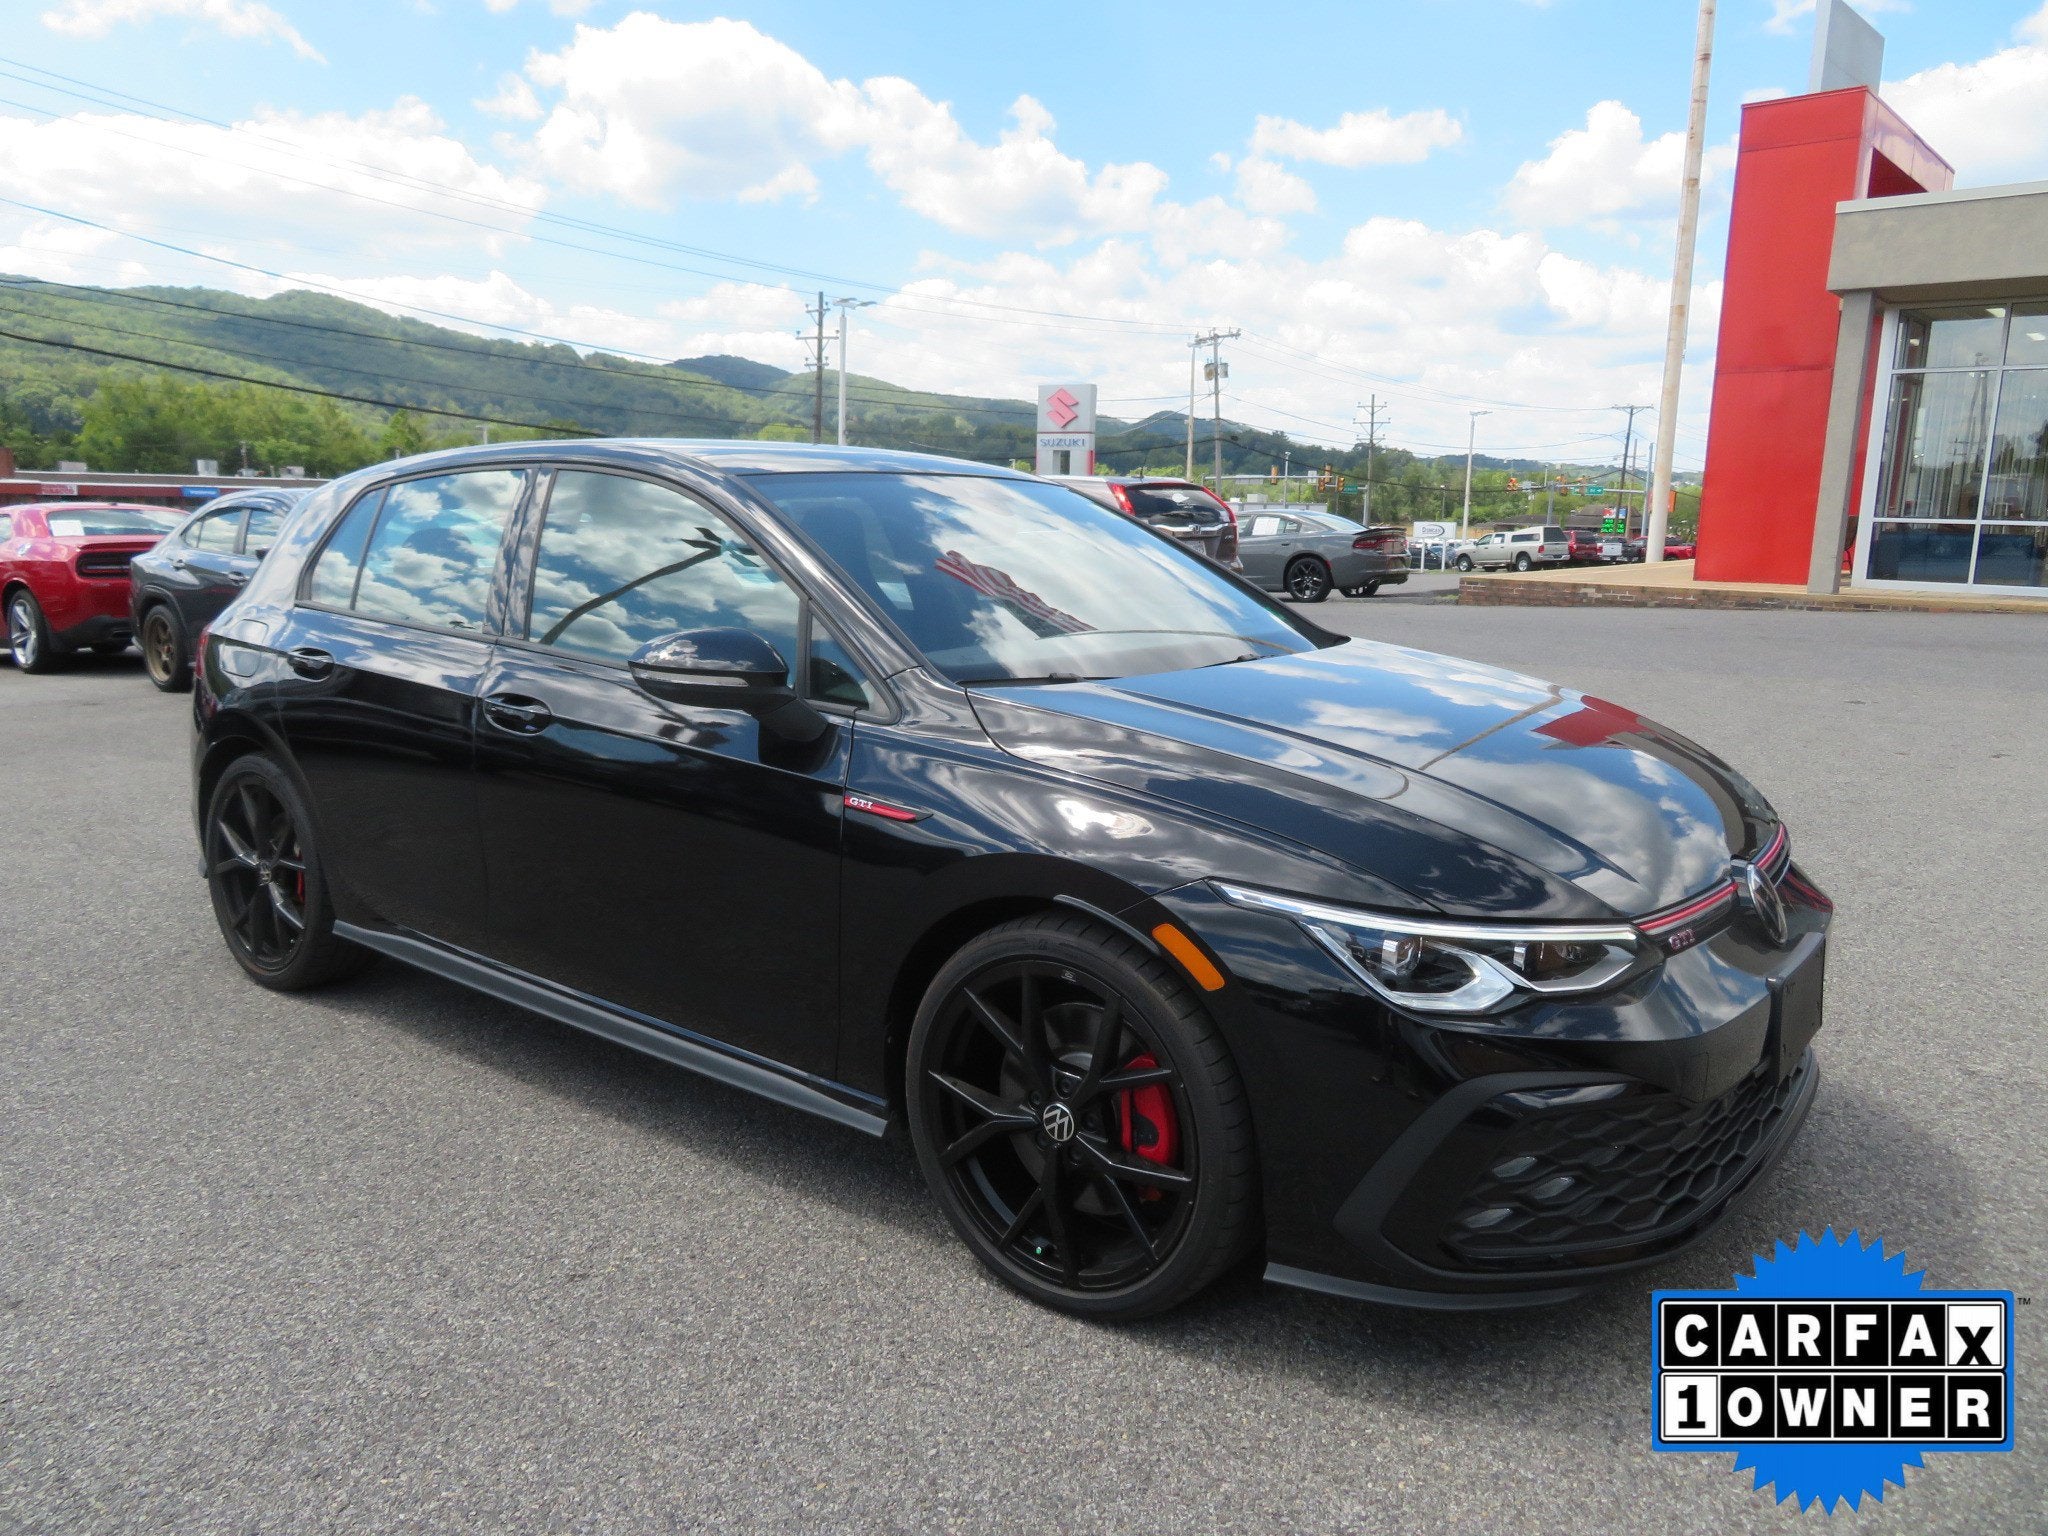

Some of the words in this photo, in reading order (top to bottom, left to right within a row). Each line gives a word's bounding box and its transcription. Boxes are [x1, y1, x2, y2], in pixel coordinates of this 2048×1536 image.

[1040, 438, 1085, 447] SUZUKI
[849, 797, 873, 810] GTI
[1668, 929, 1696, 951] GTI
